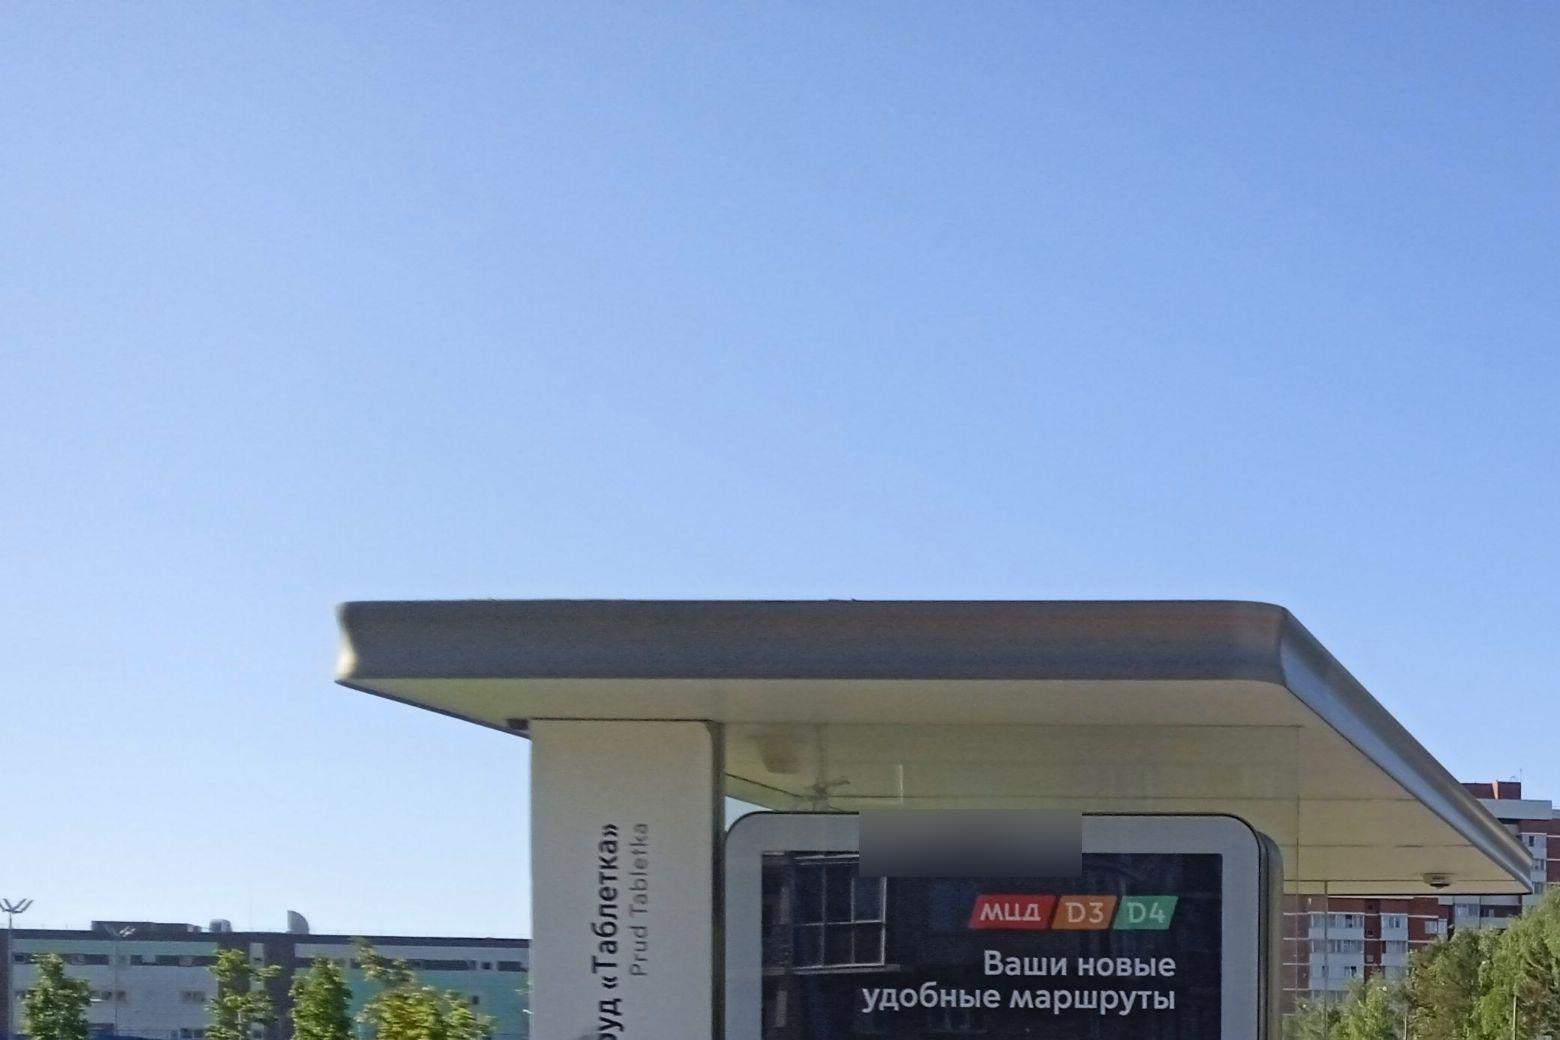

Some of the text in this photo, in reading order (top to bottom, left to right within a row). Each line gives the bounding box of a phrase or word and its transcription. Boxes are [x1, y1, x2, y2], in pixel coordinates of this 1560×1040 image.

[590, 823, 620, 990] «Таблетка»
[629, 823, 648, 976] Prud Tabletka
[980, 902, 1166, 923] МЦД D3 D4
[984, 950, 1176, 977] Ваши новые
[862, 981, 1175, 1015] удобные маршруты
